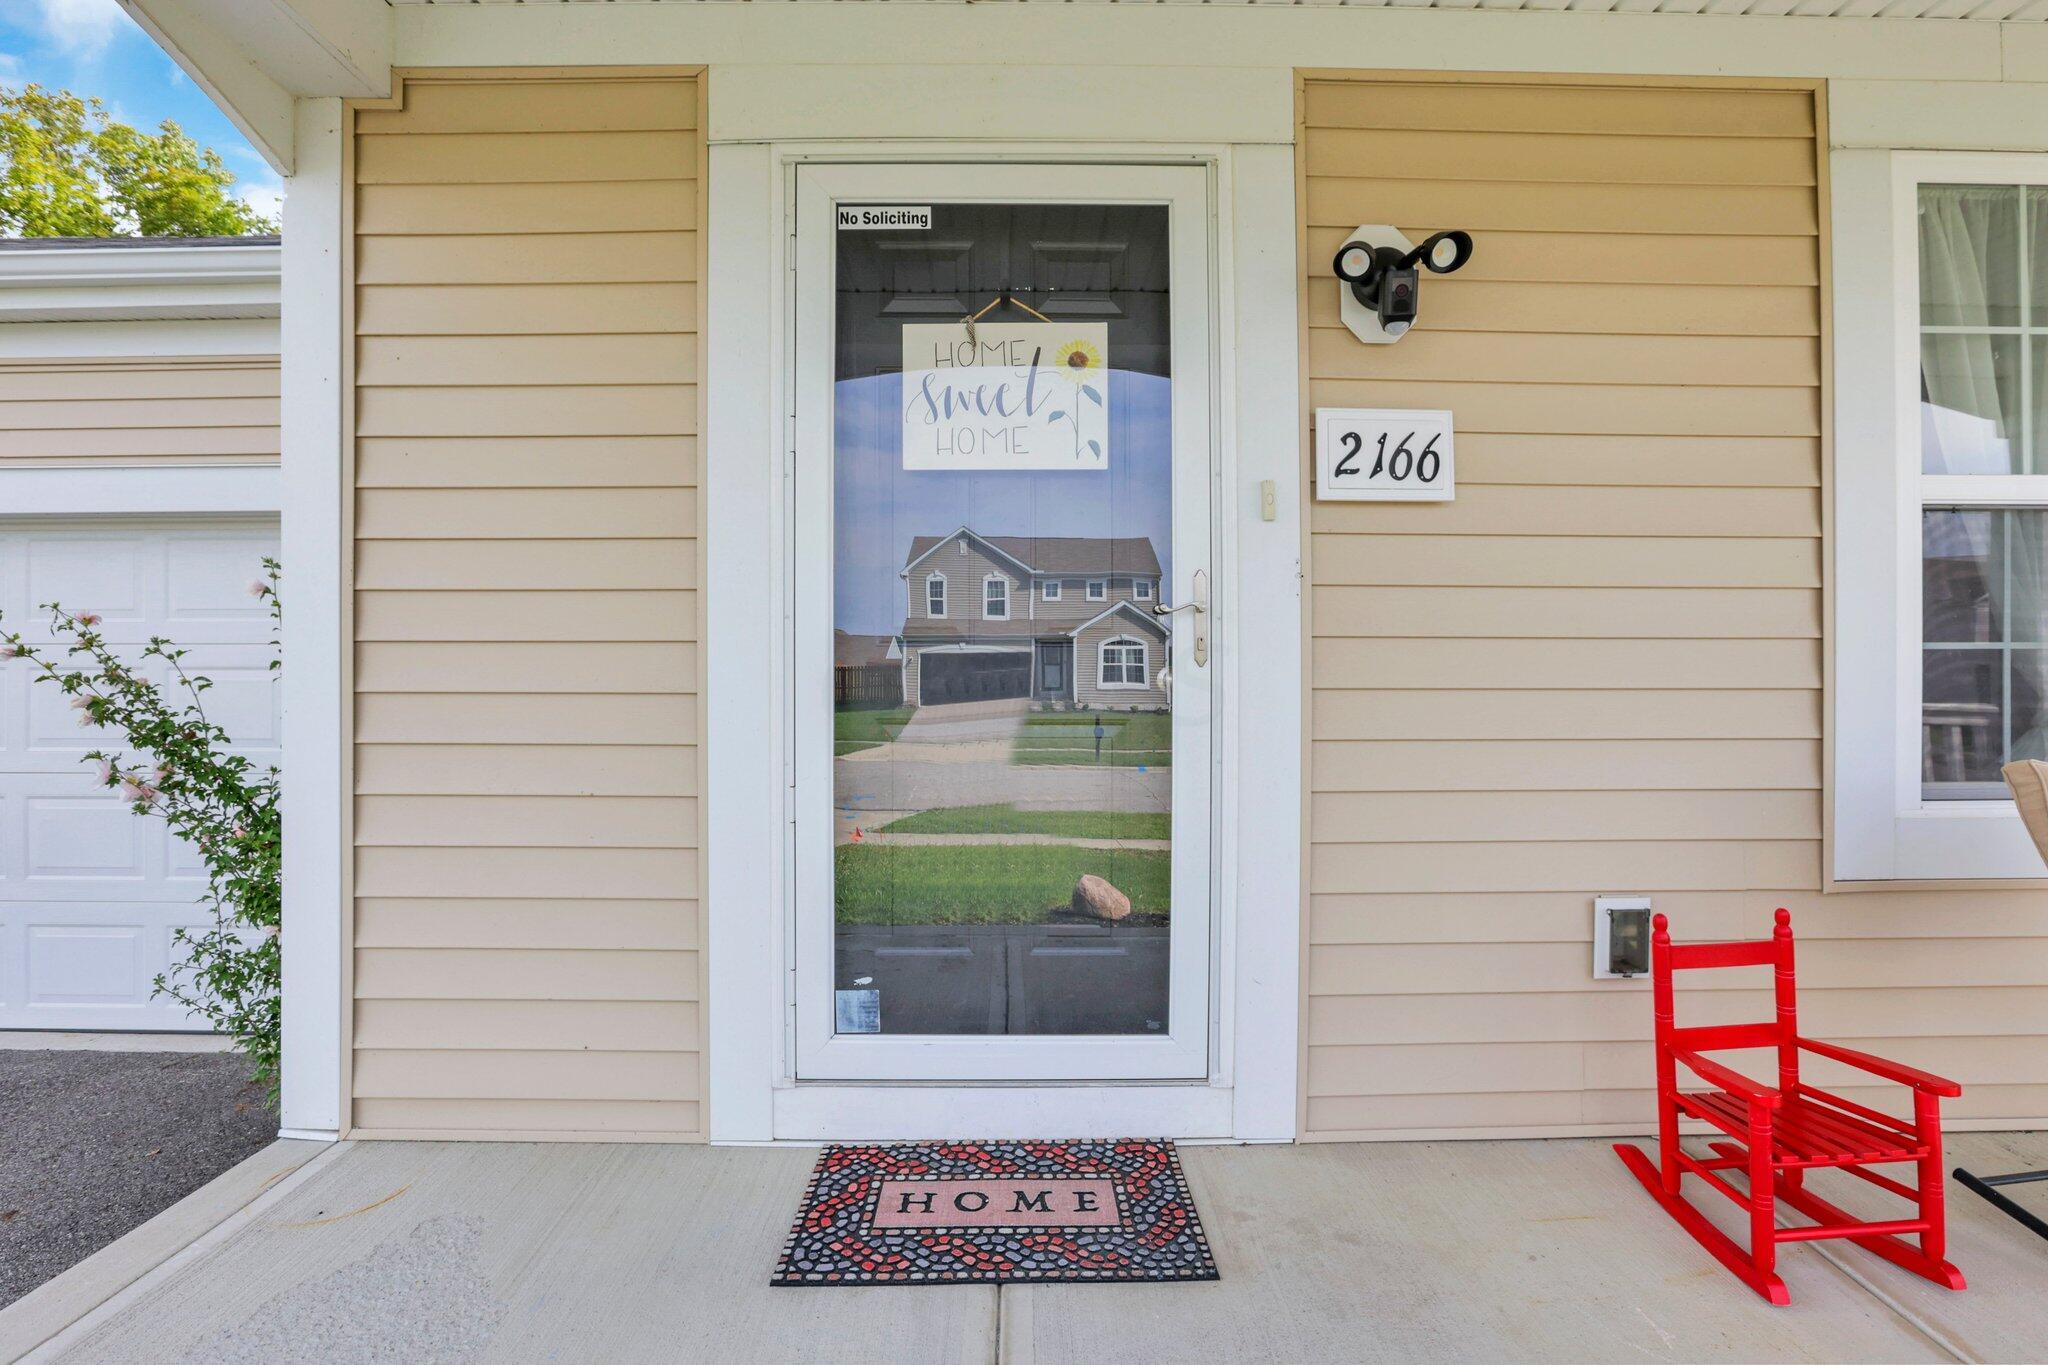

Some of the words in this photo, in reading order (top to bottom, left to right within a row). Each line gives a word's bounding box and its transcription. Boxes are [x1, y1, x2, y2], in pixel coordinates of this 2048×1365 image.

[840, 211, 858, 225] No
[863, 211, 928, 228] Soliciting
[934, 339, 1026, 368] HOME
[936, 426, 1030, 456] HOME
[1334, 431, 1442, 483] 2166
[896, 1190, 1101, 1214] HOME
